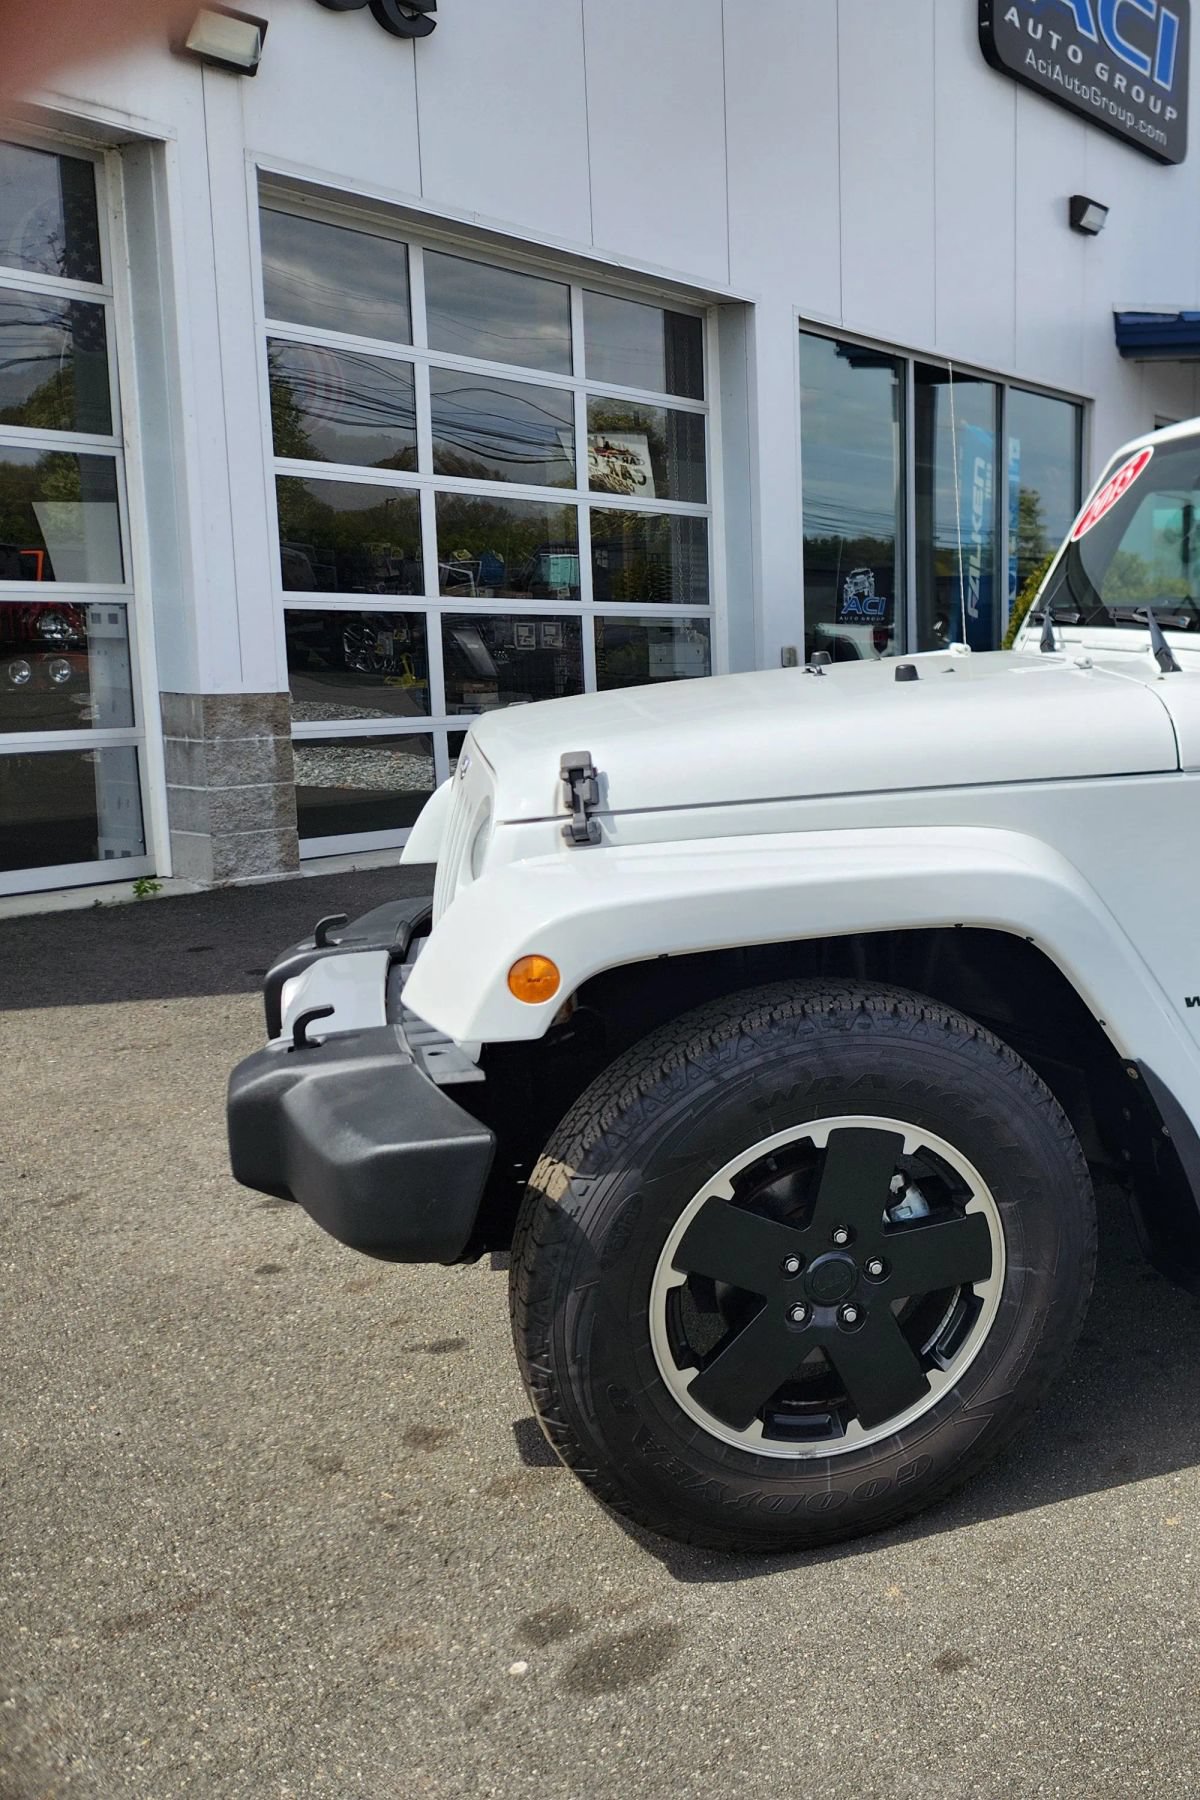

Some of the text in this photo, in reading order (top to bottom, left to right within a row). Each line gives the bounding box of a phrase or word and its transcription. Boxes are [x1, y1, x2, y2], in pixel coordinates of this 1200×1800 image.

[1003, 6, 1179, 122] AUTO GROUP
[1024, 48, 1168, 146] AciAutoGroup.com
[967, 456, 985, 619] FALKEN
[841, 596, 887, 615] ACI
